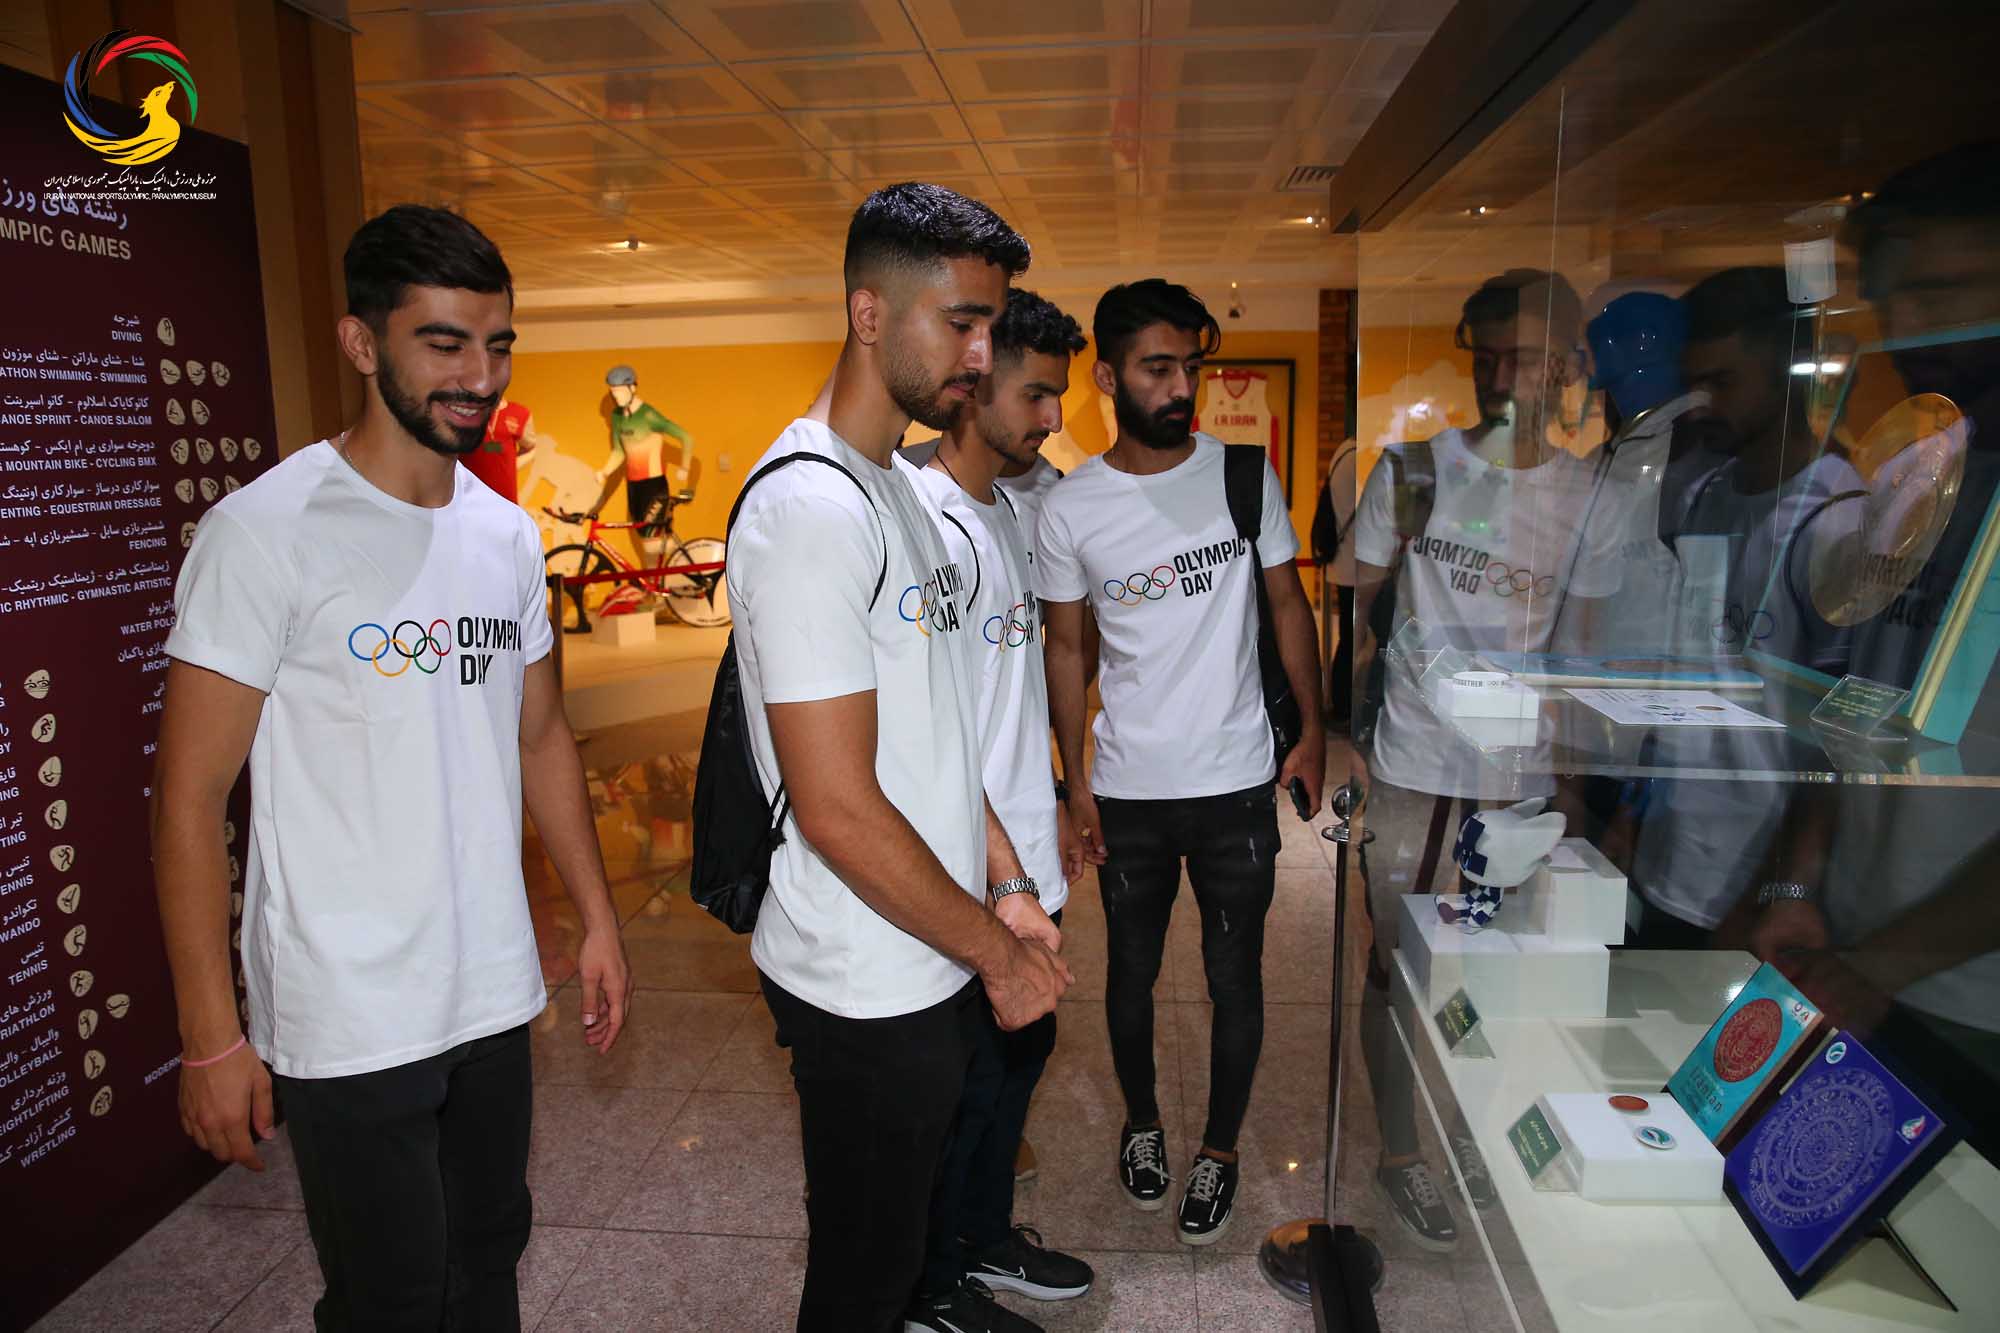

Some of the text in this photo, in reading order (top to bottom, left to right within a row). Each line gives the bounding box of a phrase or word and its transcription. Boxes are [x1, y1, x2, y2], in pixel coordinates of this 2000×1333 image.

[1, 177, 128, 230] رشته های ورز
[0, 216, 132, 260] MPIC GAMES
[113, 313, 141, 328] شیرجه
[111, 329, 143, 343] DIVING
[0, 366, 37, 379] ATHON
[40, 368, 92, 382] SWIMMING
[100, 372, 148, 385] SWIMMING
[1, 413, 32, 425] ANOE
[34, 413, 72, 425] SPRINT
[80, 414, 114, 425] CANOE
[115, 414, 153, 426] SLALOM
[0, 439, 31, 456] کوهست
[5, 459, 62, 472] MOUNTAIN
[65, 458, 88, 470] BIKE
[96, 457, 136, 469] CYCLING
[138, 456, 157, 467] BMX
[1, 505, 41, 519] ENTING
[50, 500, 112, 515] EQUESTRIAN
[114, 497, 162, 510] DRESSAGE
[128, 536, 167, 550] FENCING
[1173, 536, 1246, 575] OLYMPIC
[15, 593, 70, 612] RHYTHMIC
[77, 583, 132, 601] GYMNASTIC
[133, 576, 173, 592] ARTISTIC
[1181, 570, 1213, 598] DAY
[120, 616, 177, 636] WATER POLO
[142, 657, 171, 673] ARCHE
[0, 830, 27, 849] TING
[0, 874, 35, 896] ENNIS
[0, 917, 41, 943] WANDO
[8, 959, 49, 987] TENNIS
[0, 1002, 56, 1041] RIATHLON
[0, 1045, 63, 1089] OLLEYBALL
[0, 1085, 70, 1137] EIGHTLIFTING
[20, 1125, 77, 1169] WRETLING
